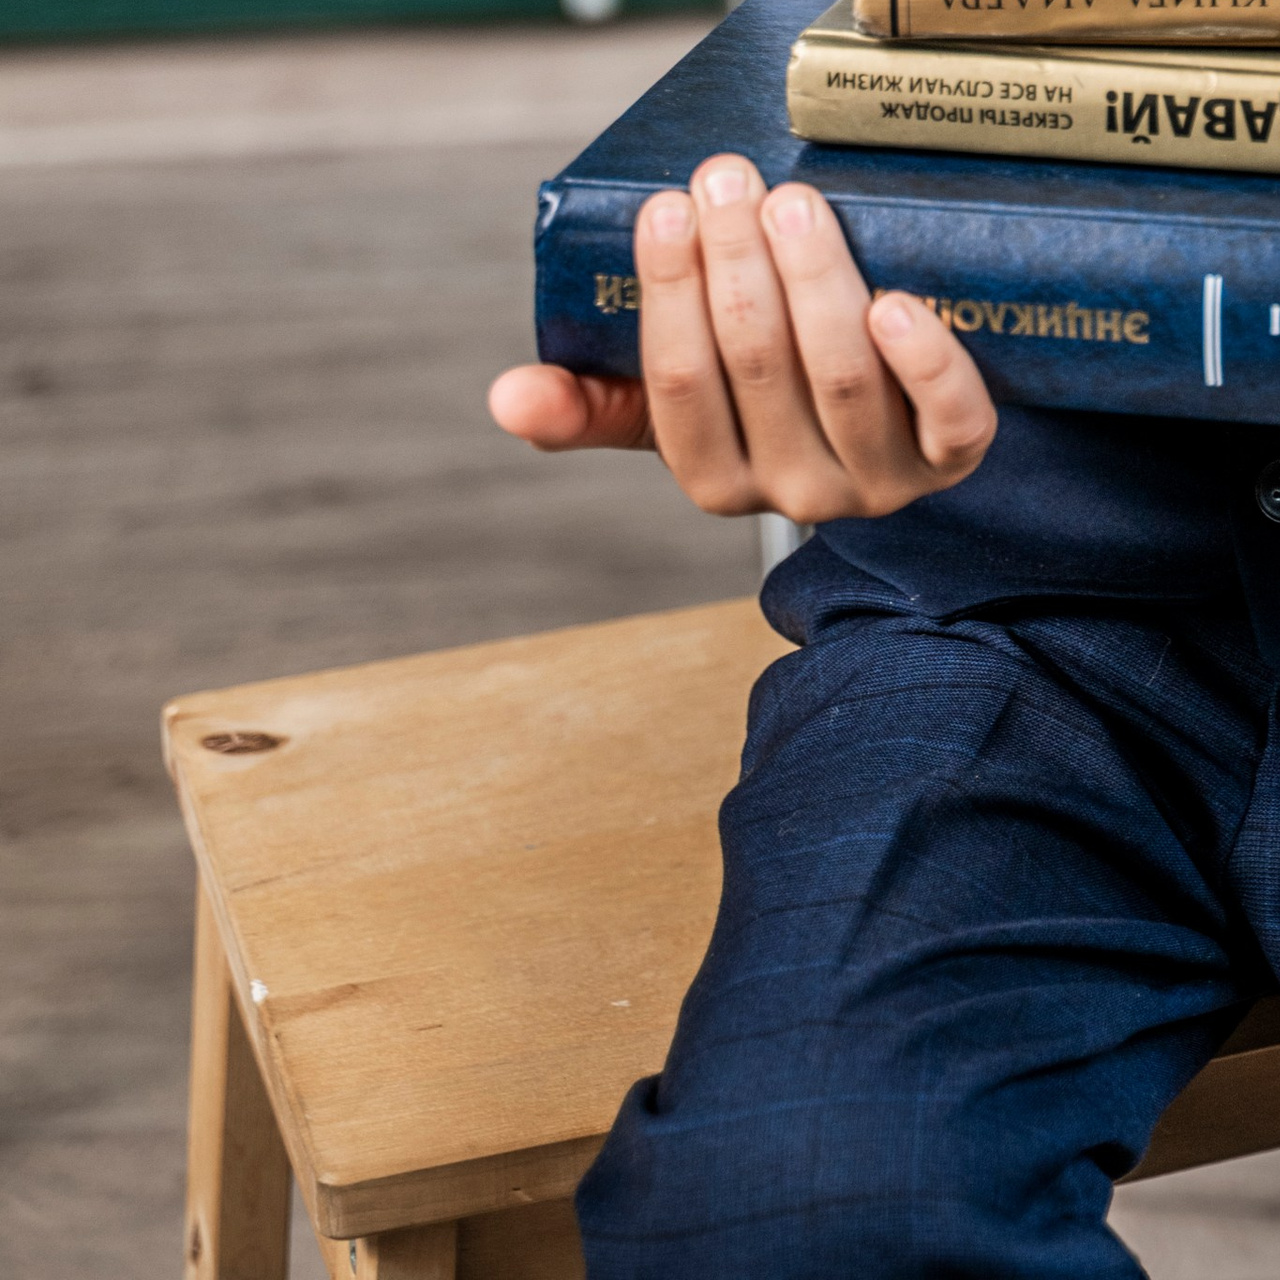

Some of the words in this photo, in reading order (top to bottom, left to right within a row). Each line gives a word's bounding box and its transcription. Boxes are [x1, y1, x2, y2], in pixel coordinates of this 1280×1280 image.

[826, 70, 903, 94] ЖИЗНИ
[909, 77, 994, 99] СЛУЧАИ
[1000, 82, 1037, 101] ВСЕ
[1044, 85, 1073, 103] НА
[881, 101, 974, 126] ПРОДАЖ
[980, 110, 1074, 130] СЕКРЕТЫ
